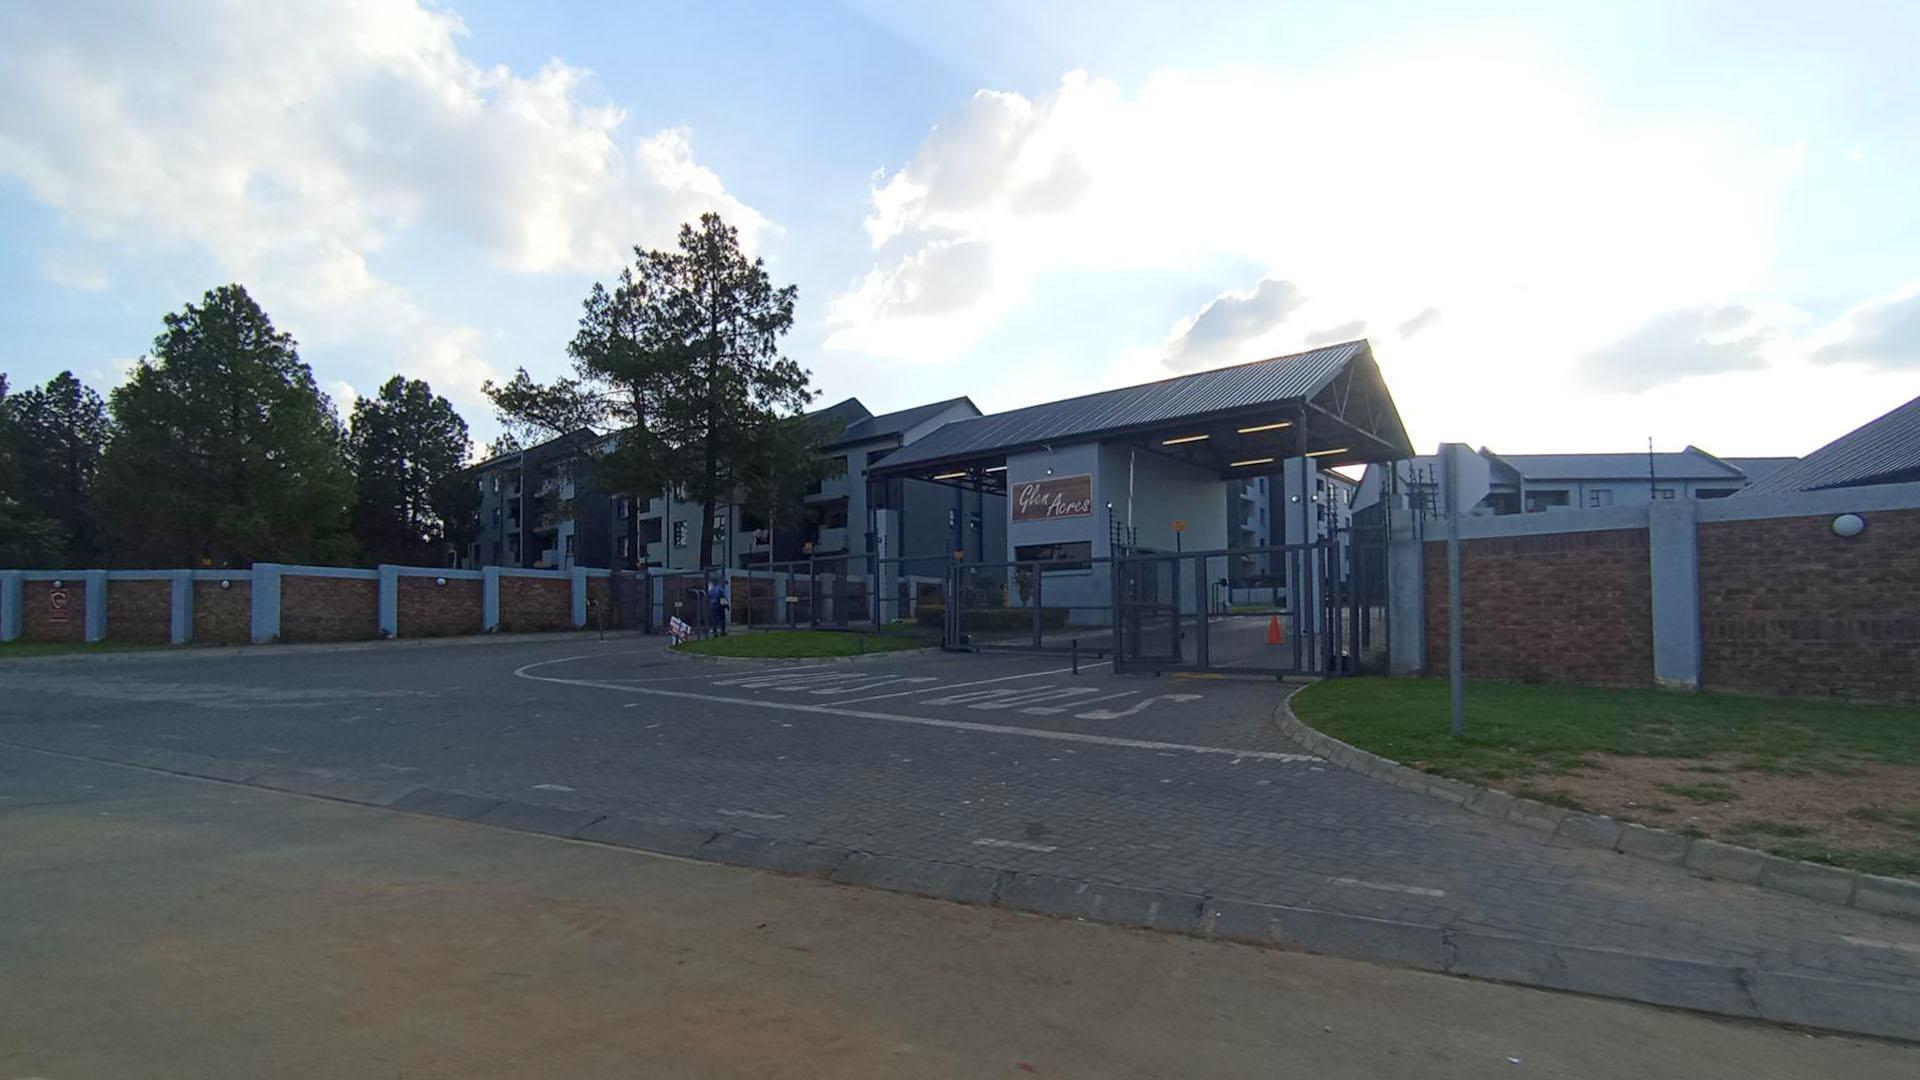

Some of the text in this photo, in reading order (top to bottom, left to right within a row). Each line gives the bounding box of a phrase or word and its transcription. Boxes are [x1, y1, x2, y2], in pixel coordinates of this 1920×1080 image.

[1019, 484, 1090, 516] Glen Acres
[919, 685, 1202, 720] STOP
